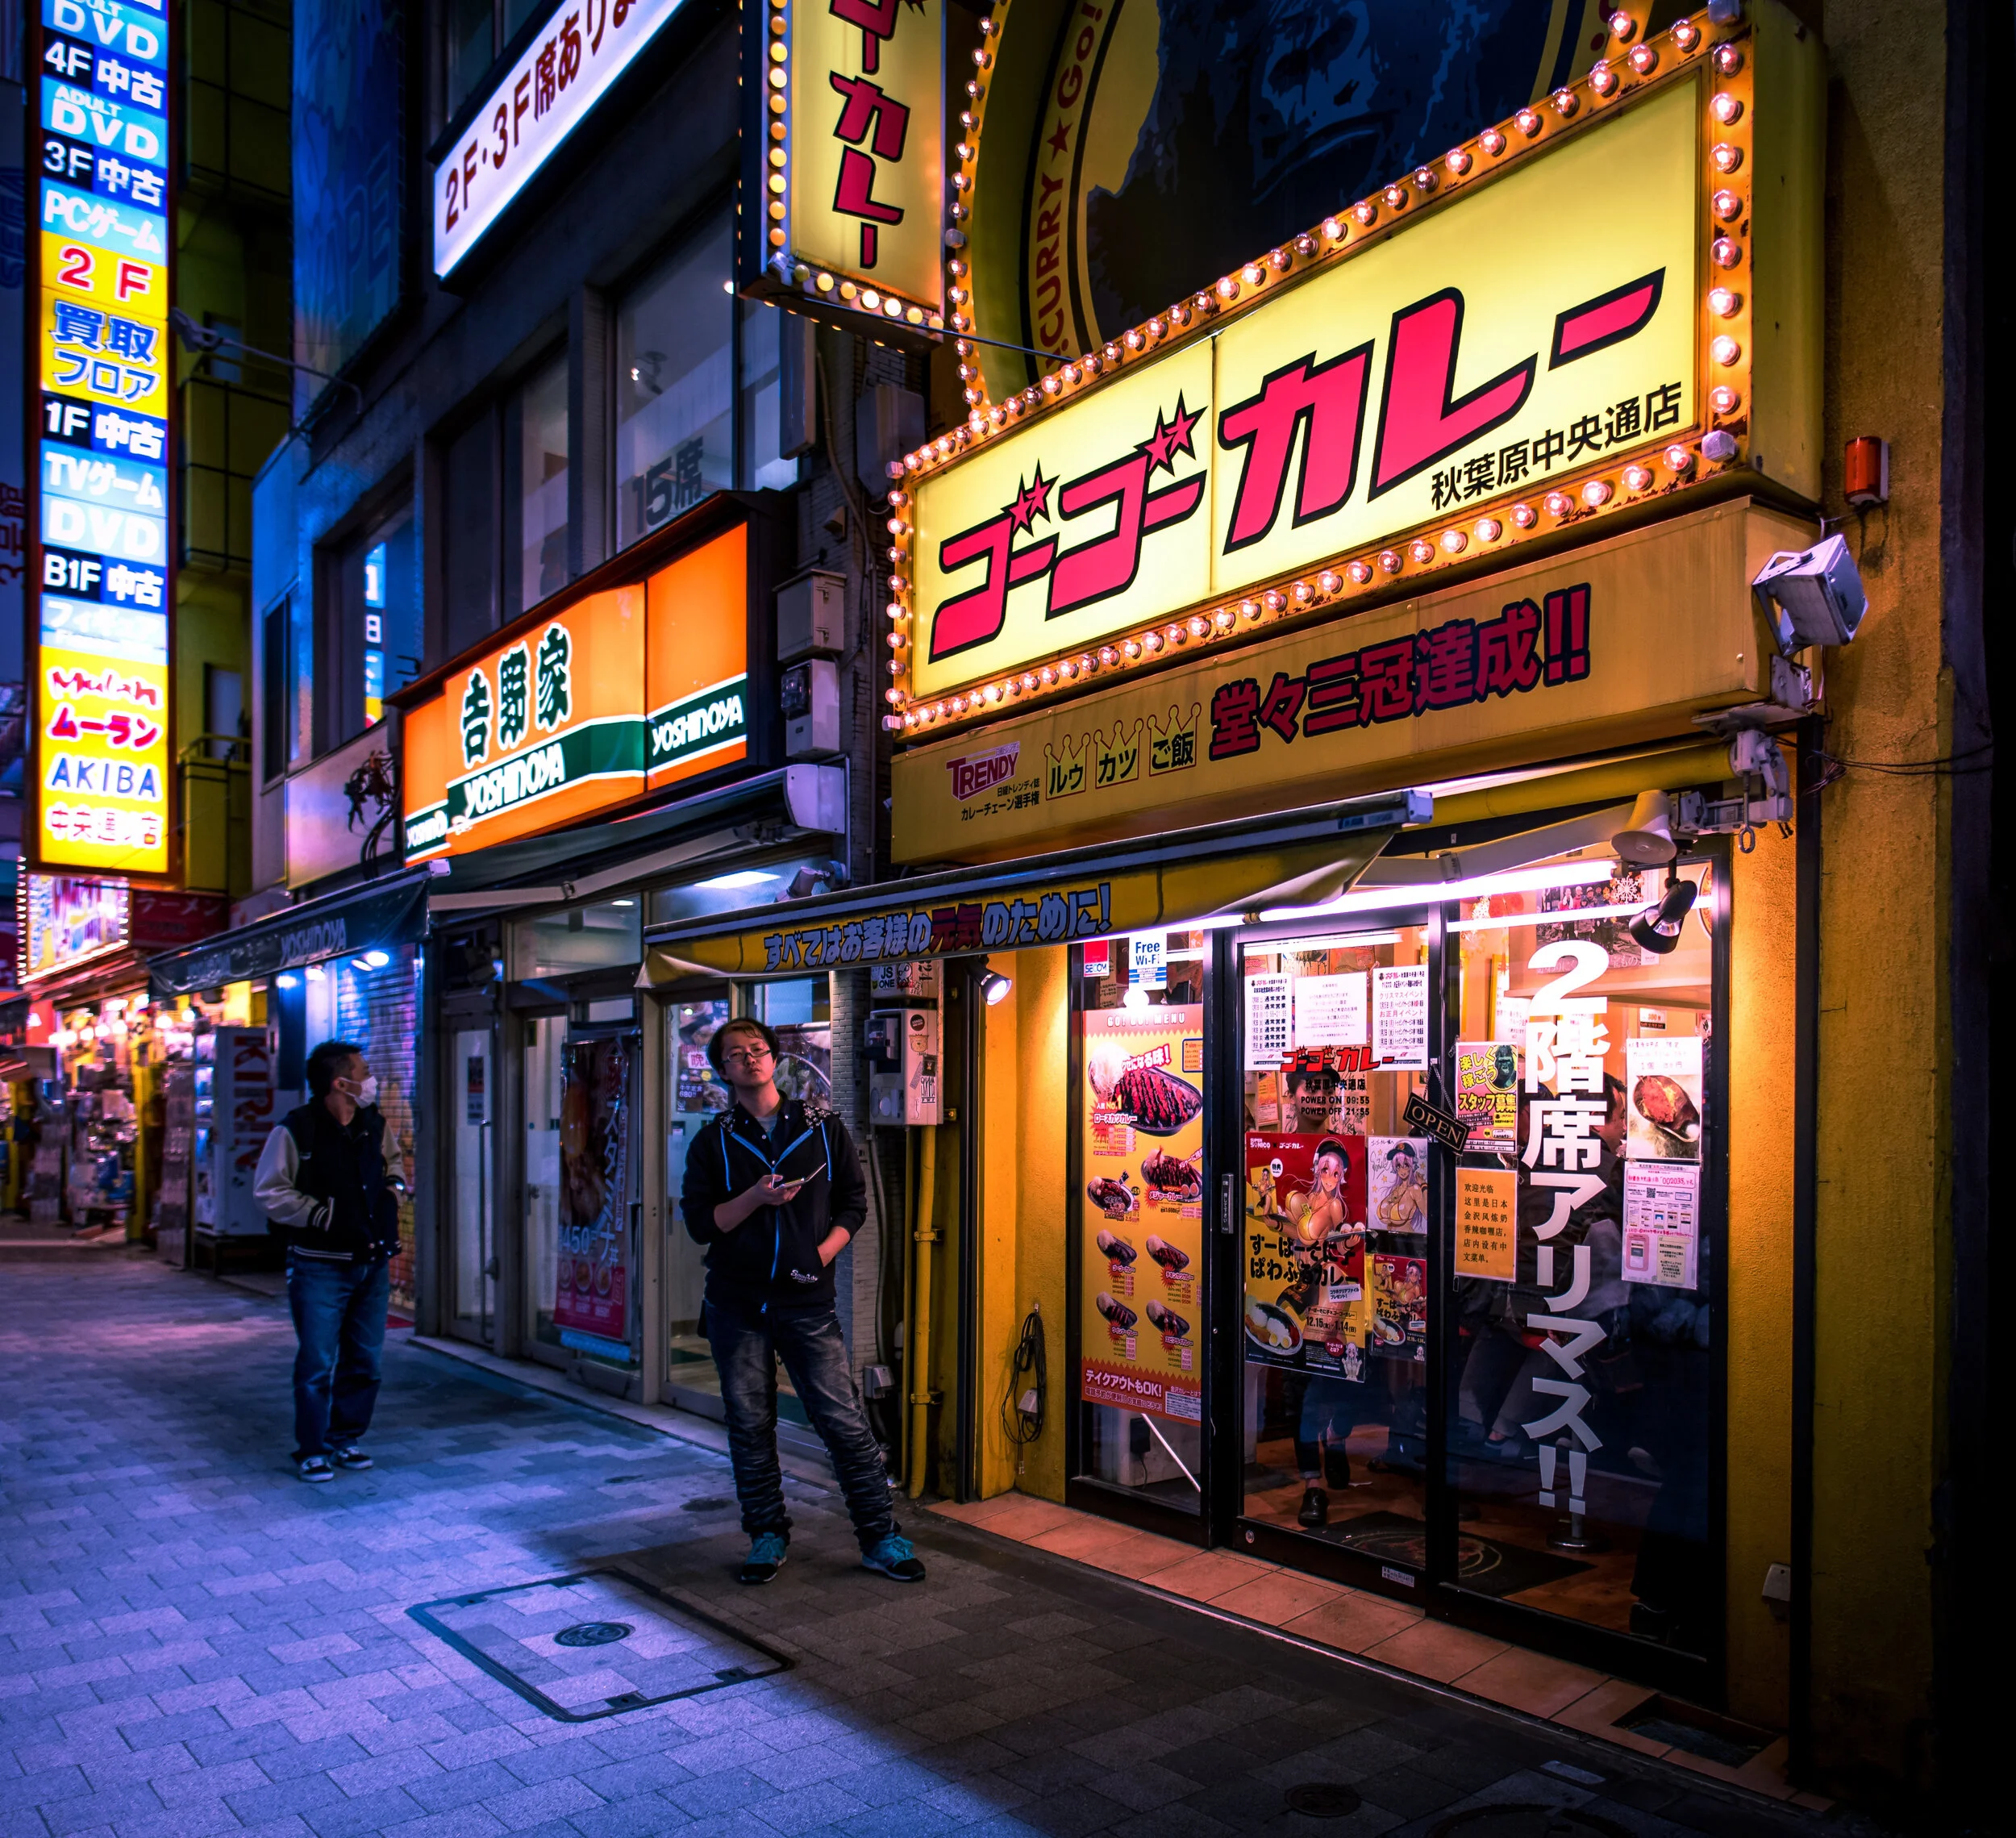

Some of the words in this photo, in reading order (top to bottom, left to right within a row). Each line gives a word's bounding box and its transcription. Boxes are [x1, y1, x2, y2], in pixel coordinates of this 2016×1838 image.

[53, 1, 159, 60] DVD
[1057, 2, 1104, 110] GO!
[45, 42, 93, 78] 4F
[98, 59, 165, 110] 中古
[56, 85, 123, 118] ADULT
[51, 98, 160, 161] DVD
[44, 140, 93, 178] 3F
[98, 158, 165, 207] 中古
[44, 190, 162, 254] PCゲーム
[52, 301, 159, 368] 買取
[52, 348, 160, 401] フロア
[45, 402, 90, 439] 1F
[95, 412, 165, 461] 中古
[1431, 381, 1681, 511] 秋葉原中央通店
[45, 452, 163, 509] TVゲーム
[929, 267, 1665, 665] ゴーゴーカレー
[632, 436, 703, 535] 15席
[48, 499, 160, 562] DVD
[44, 553, 102, 592] B1F
[106, 565, 165, 607] 中古
[1210, 582, 1591, 761] 堂々三冠達成!!
[461, 623, 572, 769] 吉野家
[50, 706, 158, 749] ムーラン
[651, 694, 744, 756] YOSHINOYA
[1098, 747, 1138, 784] カツ
[1151, 731, 1194, 769] ご飯
[51, 756, 156, 798] AKIBA
[464, 742, 565, 815] YOSHINOYA
[946, 751, 1019, 802] TRENDY
[998, 777, 1040, 797] 日経トレンディ誌
[961, 790, 1040, 821] カレーチェーン選手権
[763, 883, 1113, 971] すべてはお客様の元気のために!
[1135, 942, 1160, 953] Free
[1135, 954, 1160, 966] Wi-Fi
[879, 980, 894, 989] ONE
[881, 967, 893, 979] JS
[1085, 963, 1107, 973] SECOM
[1380, 990, 1424, 1000] クリスマスイベント
[1154, 1012, 1185, 1025] MENU
[1380, 1009, 1424, 1018] お正月イベント
[1281, 1044, 1395, 1073] ゴーゴーカレー
[1459, 1046, 1496, 1072] 楽しく
[1305, 1079, 1366, 1091] 秋葉原中央通店
[1461, 1064, 1497, 1090] 稼ごう
[234, 1035, 275, 1169] KIRIN
[1106, 1095, 1123, 1110] No.1
[1301, 1096, 1326, 1105] POWER
[1328, 1096, 1342, 1105] ON
[1346, 1096, 1370, 1105] 09:55
[1301, 1107, 1326, 1116] POWER
[1328, 1107, 1342, 1116] OFF
[1346, 1107, 1370, 1116] 21:55
[1459, 1092, 1517, 1113] スタッフ募集
[1093, 1114, 1138, 1125] ロースカツカレー
[1411, 1105, 1462, 1144] OPEN
[1149, 1190, 1183, 1202] メジャーカレー
[1464, 1183, 1494, 1194] 欢迎光临
[1464, 1197, 1508, 1209] 这里是日本
[1464, 1239, 1507, 1252] 店内设有中
[1521, 940, 1611, 1515] 2階席アリマス!!
[1250, 1257, 1360, 1287] ぱわふるカレー
[1085, 1369, 1161, 1397] テイクアウトもOK!
[1170, 1386, 1201, 1397] 金沢カレーとは?
